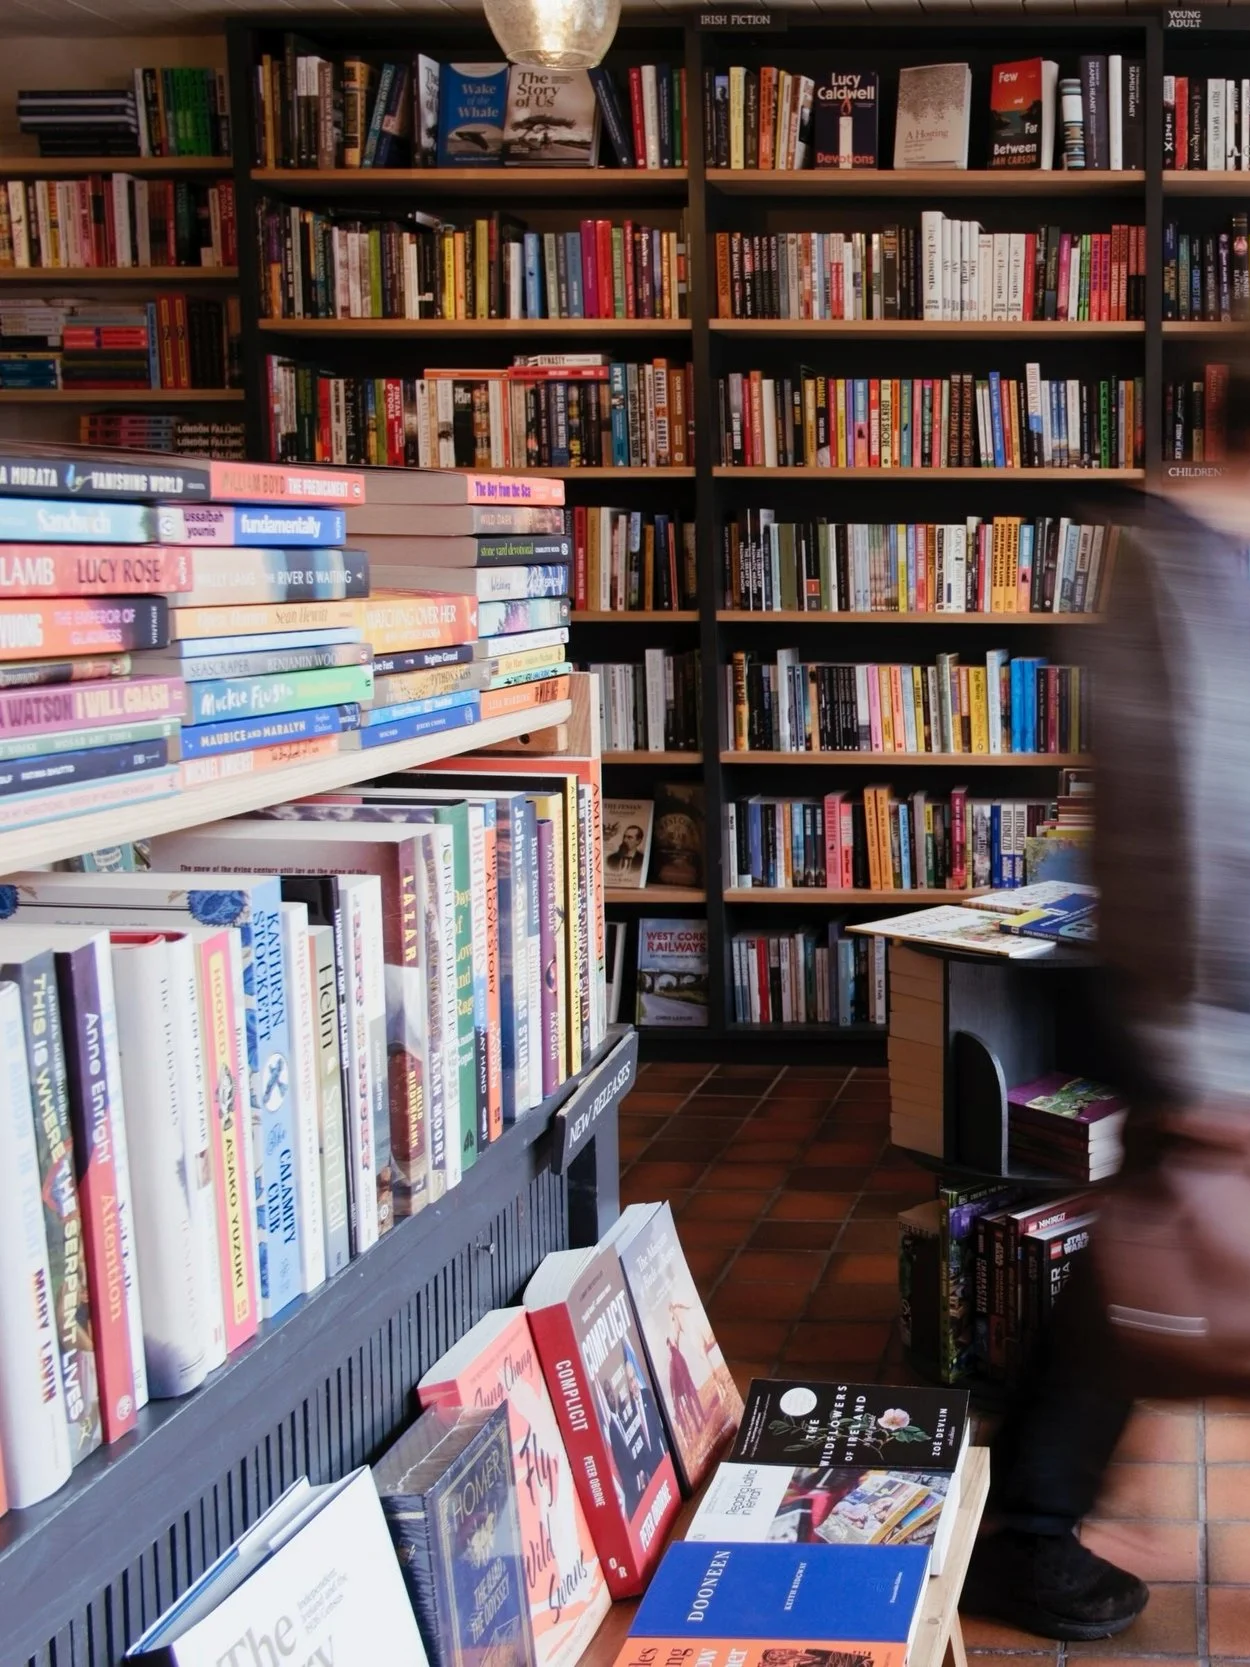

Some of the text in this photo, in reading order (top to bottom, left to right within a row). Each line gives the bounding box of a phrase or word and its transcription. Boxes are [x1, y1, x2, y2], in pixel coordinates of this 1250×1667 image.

[700, 14, 771, 25] IRISH FICTION
[1168, 10, 1201, 28] YOUNG ADULT
[461, 83, 496, 94] Wake
[516, 84, 560, 97] Story
[518, 72, 548, 84] The
[831, 72, 861, 87] Lucy
[998, 72, 1018, 83] Few
[515, 96, 555, 108] of Us
[817, 85, 875, 100] Caldwell
[458, 106, 499, 117] Whale
[1025, 121, 1038, 134] Far
[816, 153, 875, 165] Devotions
[993, 143, 1037, 155] Between
[1007, 154, 1037, 165] CARSON
[718, 235, 727, 296] CONFESSIONS
[928, 243, 936, 290] Elements
[540, 356, 565, 364] DYNASTY
[387, 383, 395, 419] O'TOOLE
[882, 426, 890, 449] SHORE
[11, 466, 184, 494] MURATA VANISHING WORLD
[222, 471, 348, 497] WILLIAM BOYD THE PREDICAMENT
[1167, 467, 1222, 477] CHILDREN
[475, 481, 531, 499] The Boy from Sea
[37, 508, 112, 535] Sandwich
[187, 526, 217, 539] younis
[240, 513, 321, 538] fundamentally
[508, 543, 534, 556] devotional
[0, 556, 162, 586] LAMB LUCY ROSE
[277, 570, 352, 585] RIVER IS WAITING
[74, 608, 136, 625] EMPEROR OF
[300, 605, 329, 623] Hewitt
[415, 603, 457, 625] OVER HER
[191, 653, 312, 678] SEASCRAPER BENJAMIN
[8, 684, 171, 728] WATSON I WILL CRASH
[200, 720, 306, 748] MAURICE AND MARALYN
[593, 783, 605, 973] AMITAV GHOSH
[402, 875, 417, 962] LAZAR
[442, 843, 457, 1032] JOHN LANCHESTER
[513, 805, 530, 1086] John John DOUGLAS STUART
[646, 931, 706, 942] WEST CORK
[646, 941, 707, 953] RAILWAYS
[296, 930, 311, 1029] Imperfect
[486, 886, 499, 1089] LOVE STORY HAYDEN
[478, 1023, 488, 1094] MAY HAND
[252, 909, 297, 1246] KATHRYN STOCKETT CALAMITY CLUB
[317, 963, 346, 1235] Helm Sarah Hall
[408, 1071, 420, 1148] BIEDERMANN
[431, 1051, 445, 1165] ALAN MOORE
[568, 1060, 632, 1149] NEW RELEASES
[213, 966, 244, 1290] HOOKED ASAKO YUZUKI
[85, 1012, 122, 1323] Anne Enright Attention
[32, 973, 85, 1423] THIS IS WHERE THE SERPENT LIVES
[1038, 1212, 1066, 1229] NINJAGO
[1063, 1231, 1089, 1255] STAR WARS
[32, 1268, 57, 1405] MARY LAVIN
[581, 1288, 632, 1382] COMPLICIT
[503, 1348, 533, 1391] Chang
[554, 1358, 606, 1509] COMPLICIT PETER OBORNE
[805, 1418, 820, 1441] THE
[818, 1385, 848, 1468] WILDFLOWERS
[849, 1394, 867, 1448] IRELAND
[931, 1407, 948, 1457] ZOË DEVLIN
[844, 1450, 855, 1462] OF
[450, 1449, 502, 1532] HOMER
[524, 1512, 556, 1589] Wild
[548, 1549, 588, 1625] Swans
[687, 1550, 732, 1623] DOONEEN
[783, 1561, 807, 1612] KEITH RIDGWAY
[215, 1613, 297, 1667] The
